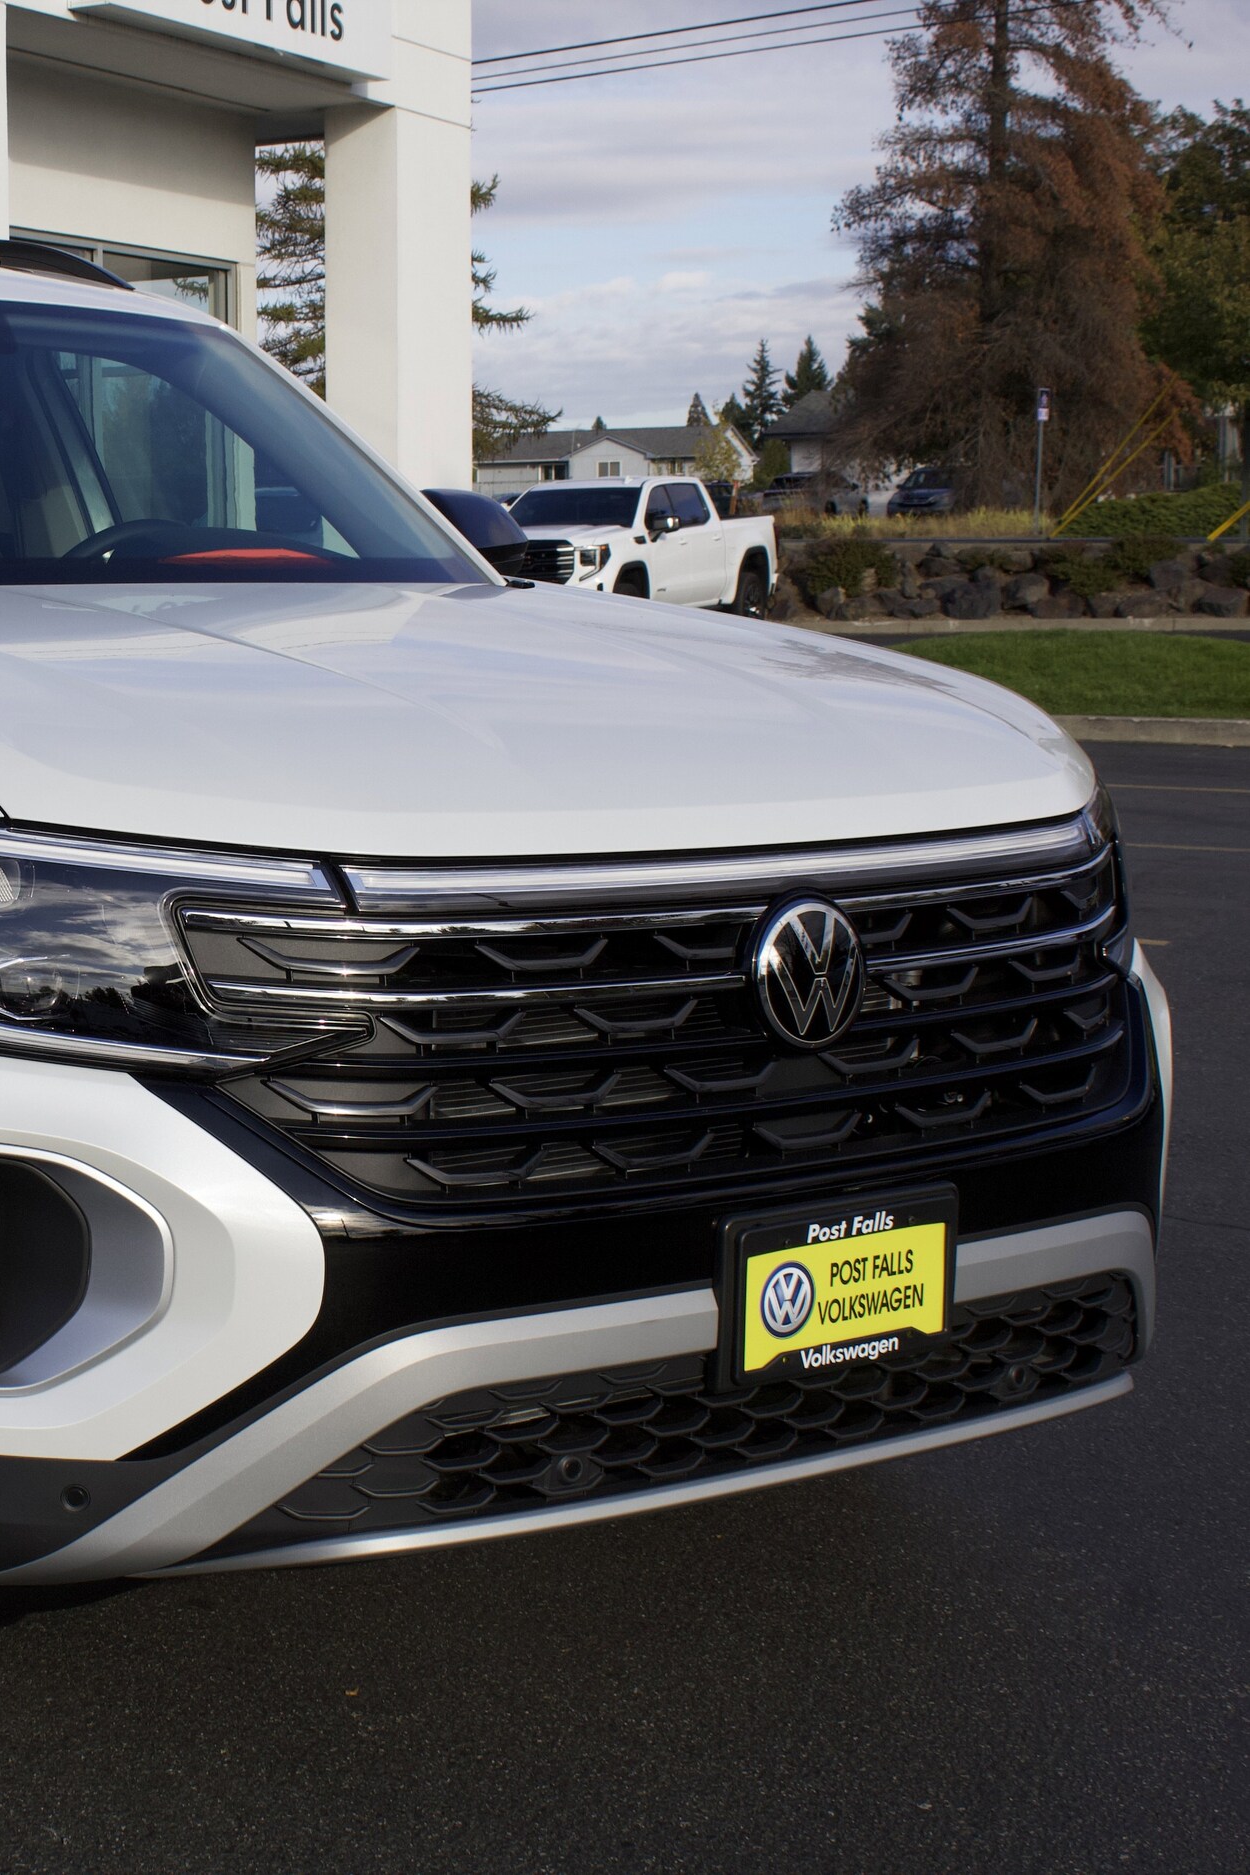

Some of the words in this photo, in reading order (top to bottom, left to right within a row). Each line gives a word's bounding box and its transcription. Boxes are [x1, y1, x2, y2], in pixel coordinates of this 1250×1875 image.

[806, 1220, 846, 1244] Post
[851, 1210, 895, 1236] Falls
[830, 1257, 868, 1287] POST
[872, 1249, 913, 1280] FALLS
[817, 1283, 924, 1325] VOLKSWAGEN
[800, 1336, 899, 1369] Volkswagen
